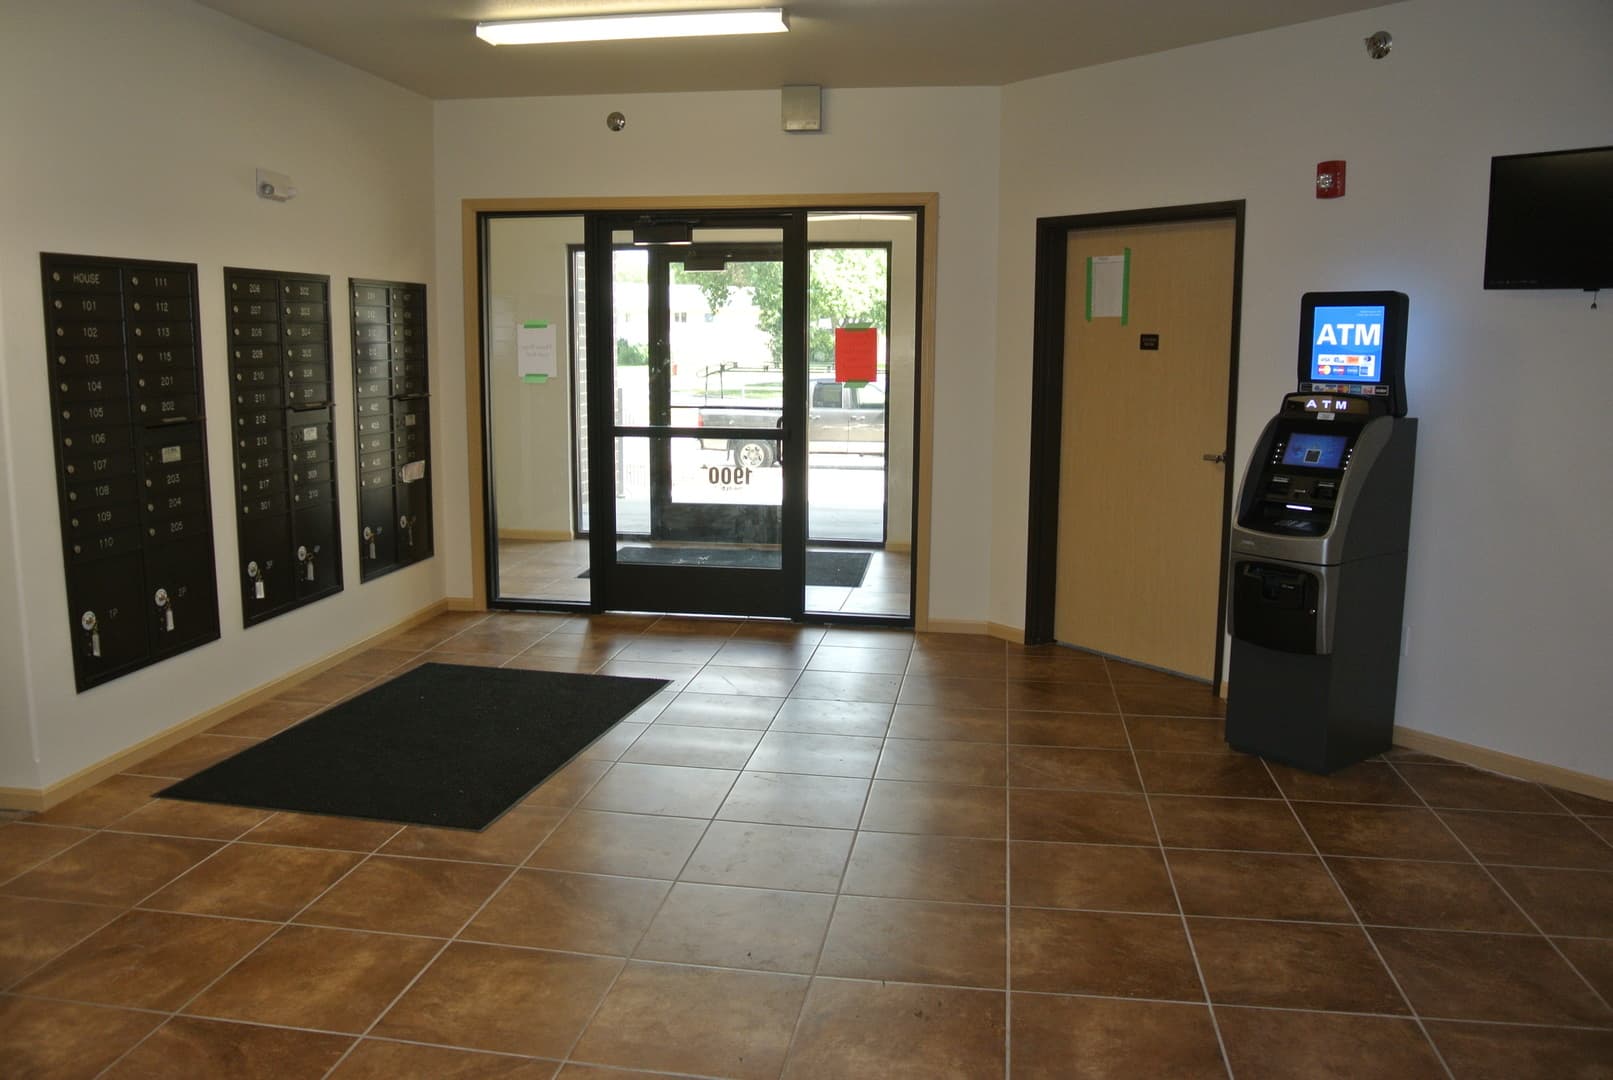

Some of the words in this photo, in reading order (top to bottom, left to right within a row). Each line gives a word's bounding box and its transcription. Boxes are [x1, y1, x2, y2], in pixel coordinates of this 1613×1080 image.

[73, 274, 100, 284] HOUSE
[155, 277, 167, 287] 111
[82, 300, 96, 311] 101
[156, 302, 168, 312] 112
[84, 327, 98, 338] 102
[1316, 323, 1380, 346] ATM
[85, 354, 100, 364] 103
[87, 381, 102, 391] 104
[1306, 399, 1347, 410] ATM
[89, 408, 103, 418] 105
[91, 434, 105, 444] 106
[93, 460, 106, 471] 107
[99, 537, 113, 548] 110
